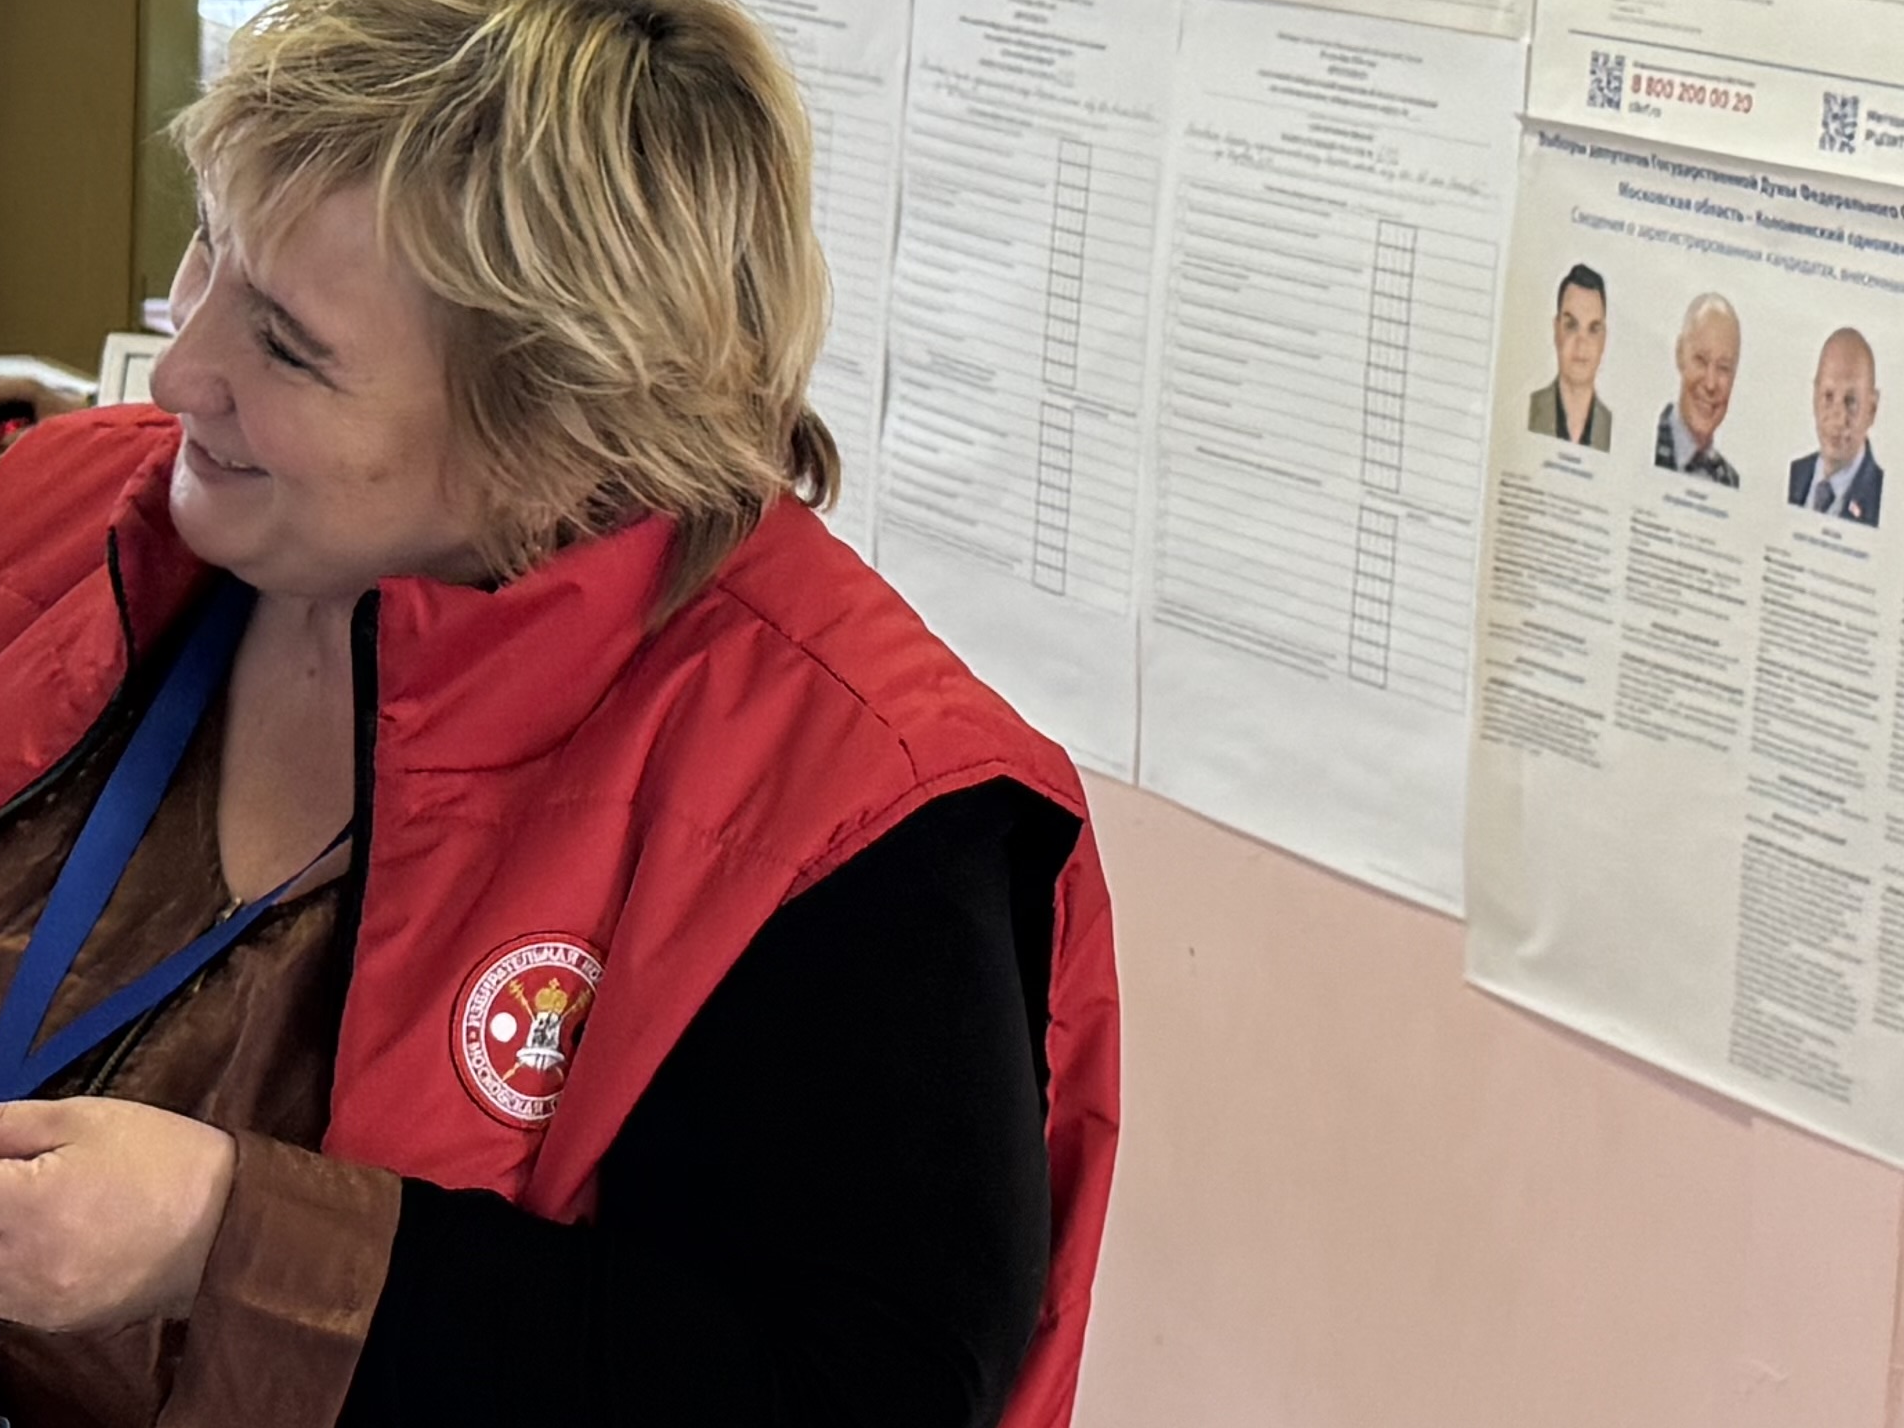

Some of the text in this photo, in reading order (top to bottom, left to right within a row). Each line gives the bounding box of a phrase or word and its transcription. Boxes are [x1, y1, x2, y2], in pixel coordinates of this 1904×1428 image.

[1678, 84, 1706, 106] 200
[1709, 88, 1729, 109] 00
[1732, 92, 1753, 114] 20
[1538, 131, 1587, 159] Выборы
[1760, 176, 1797, 199] Думы
[1799, 183, 1899, 217] Федерального
